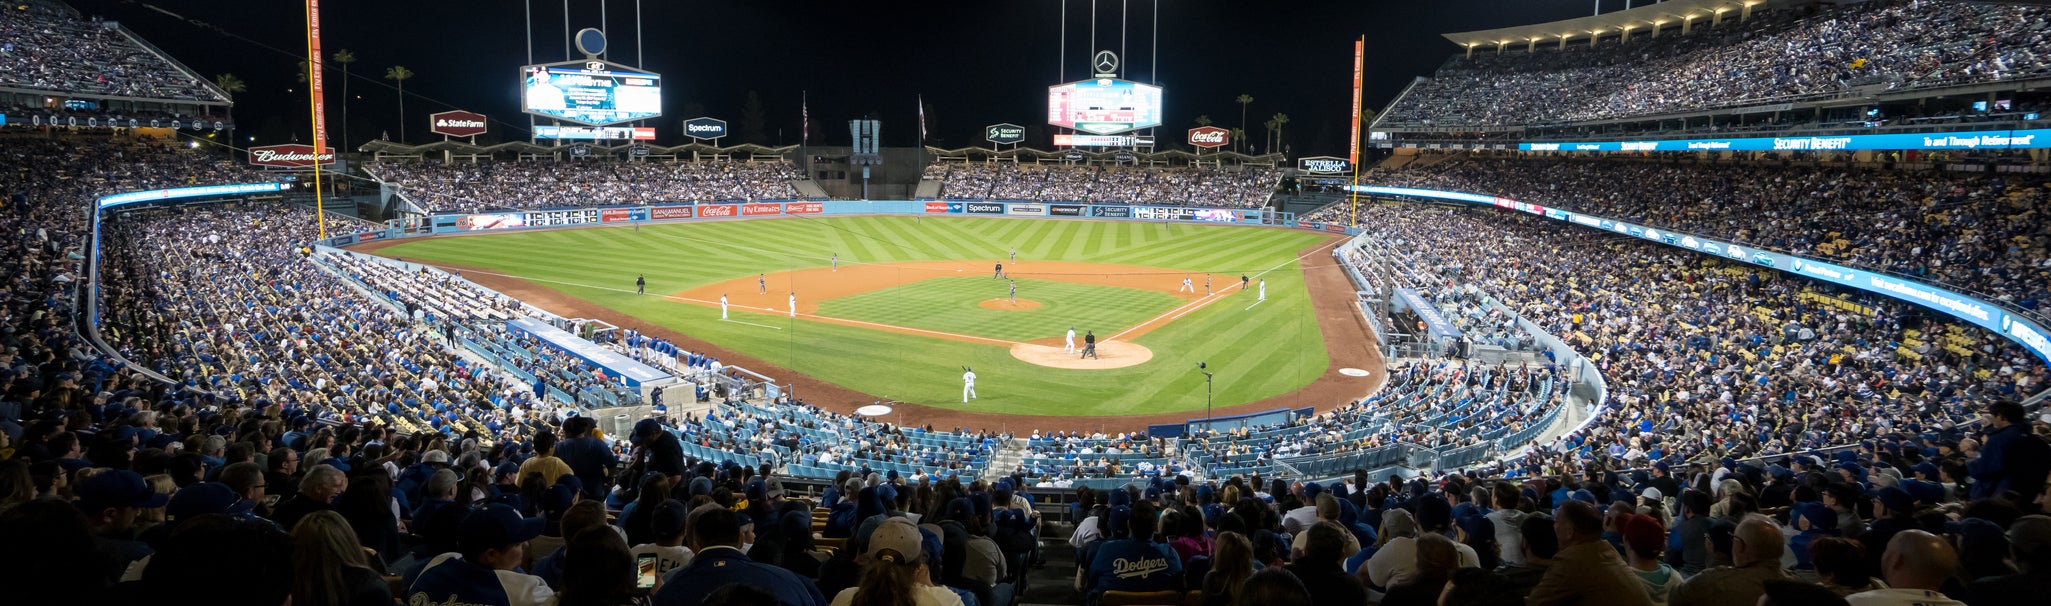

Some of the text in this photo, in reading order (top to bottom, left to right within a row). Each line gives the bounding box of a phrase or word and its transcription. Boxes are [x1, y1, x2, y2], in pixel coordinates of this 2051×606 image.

[315, 103, 323, 129] Emirates
[688, 124, 721, 132] Spectrum
[1192, 131, 1225, 142] Coca-Cola
[1932, 137, 1947, 146] and
[1949, 136, 1980, 148] Through
[1774, 138, 1810, 149] SECURITY
[254, 150, 333, 162] Budweier
[703, 207, 731, 217] Coca-Cola
[743, 206, 753, 214] Fly
[970, 204, 1001, 212] Spectrum
[1871, 276, 1884, 288] Visit
[1113, 556, 1168, 579] Dodgers
